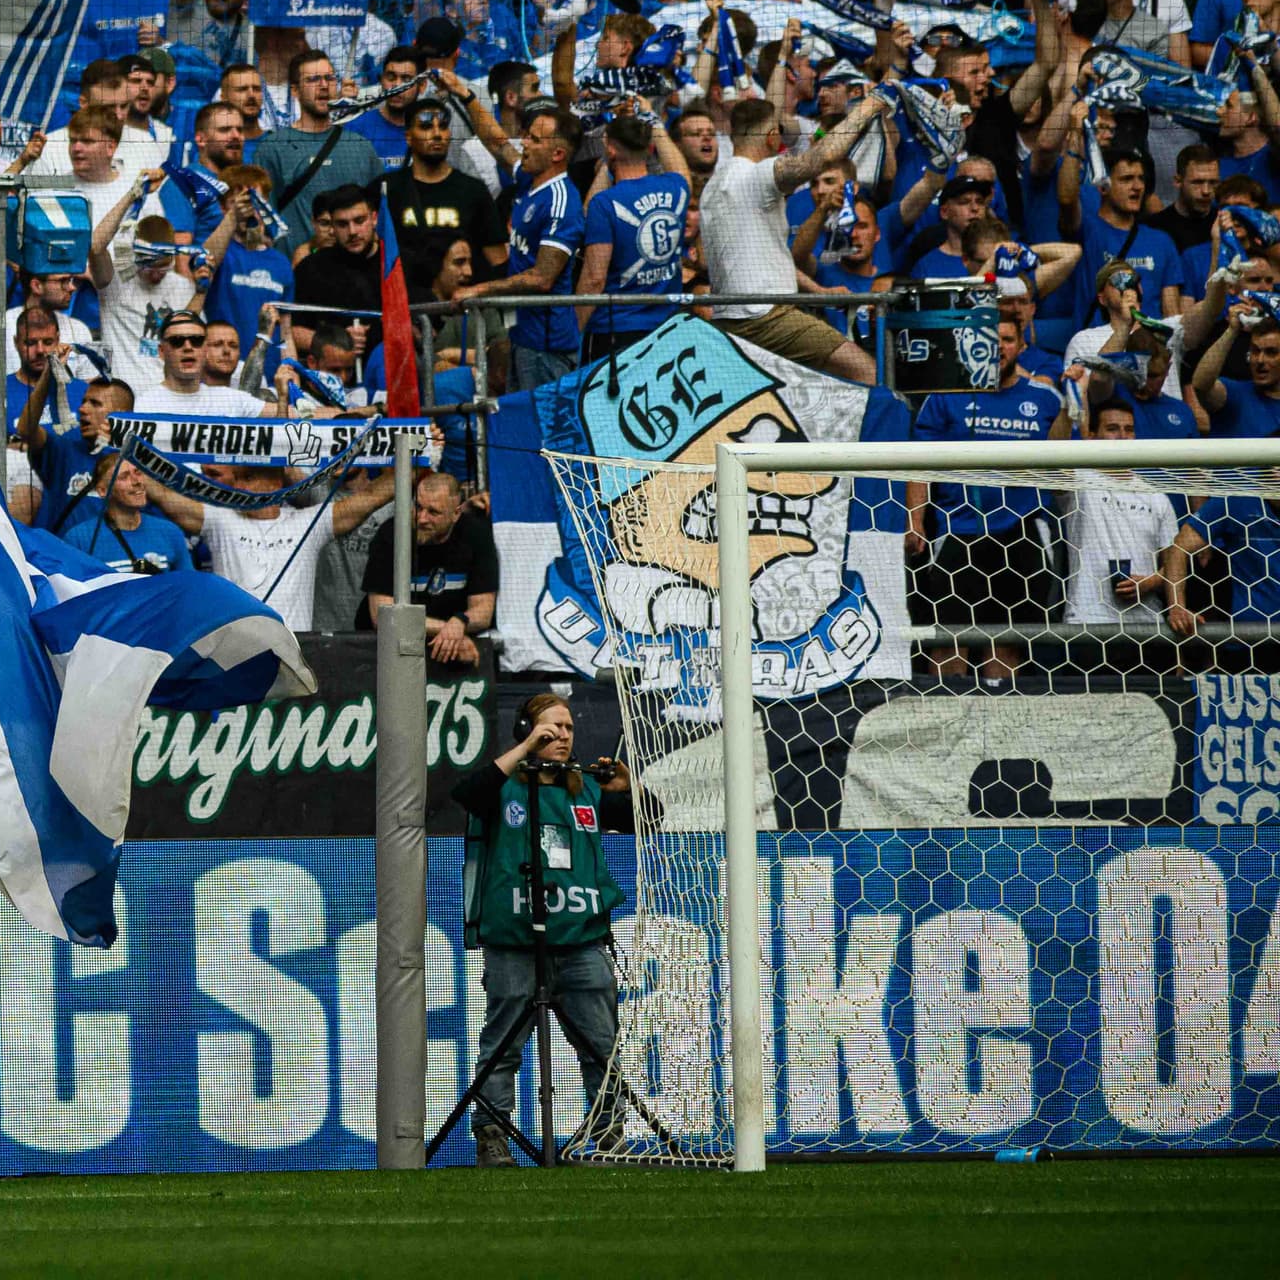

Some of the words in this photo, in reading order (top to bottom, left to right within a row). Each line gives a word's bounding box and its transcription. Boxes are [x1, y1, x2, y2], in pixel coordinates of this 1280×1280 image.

[633, 192, 673, 214] SUPER
[963, 417, 1041, 432] VICTORIA
[170, 422, 274, 457] WERDEN
[512, 886, 602, 915] HOST
